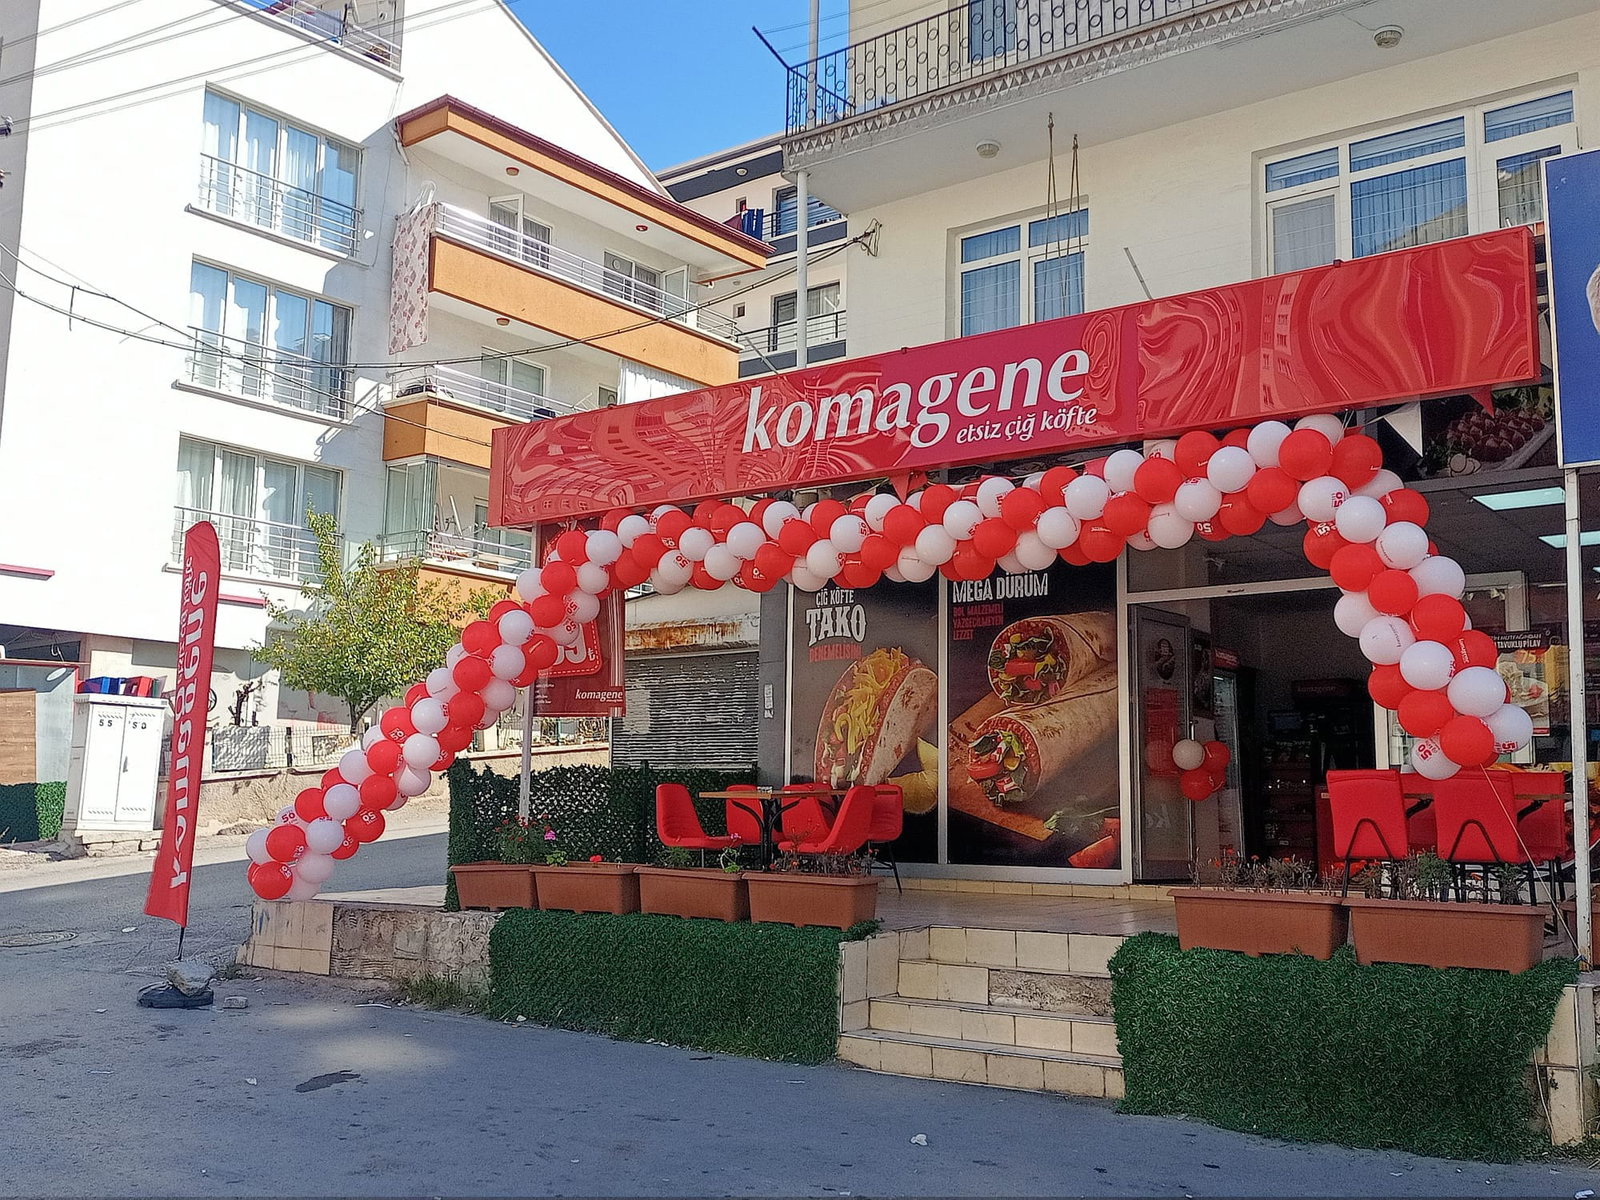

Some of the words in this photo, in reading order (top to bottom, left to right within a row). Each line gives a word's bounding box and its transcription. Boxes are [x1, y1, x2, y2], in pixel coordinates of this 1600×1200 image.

[742, 347, 1091, 454] komagene
[956, 418, 1003, 445] etsiz
[1005, 411, 1036, 442] çiğ
[1039, 405, 1098, 436] köfte
[1197, 522, 1212, 533] 50
[676, 555, 689, 568] 50
[952, 580, 993, 604] MEGA
[996, 570, 1049, 600] DÜRÜM
[830, 587, 855, 604] KÖFTE
[567, 601, 577, 614] 50
[566, 621, 576, 632] 50
[806, 604, 867, 647] TAKO
[575, 688, 623, 703] komagene
[390, 729, 404, 741] 50
[1417, 744, 1433, 761] 50
[281, 812, 296, 824] 50
[362, 811, 376, 822] 50
